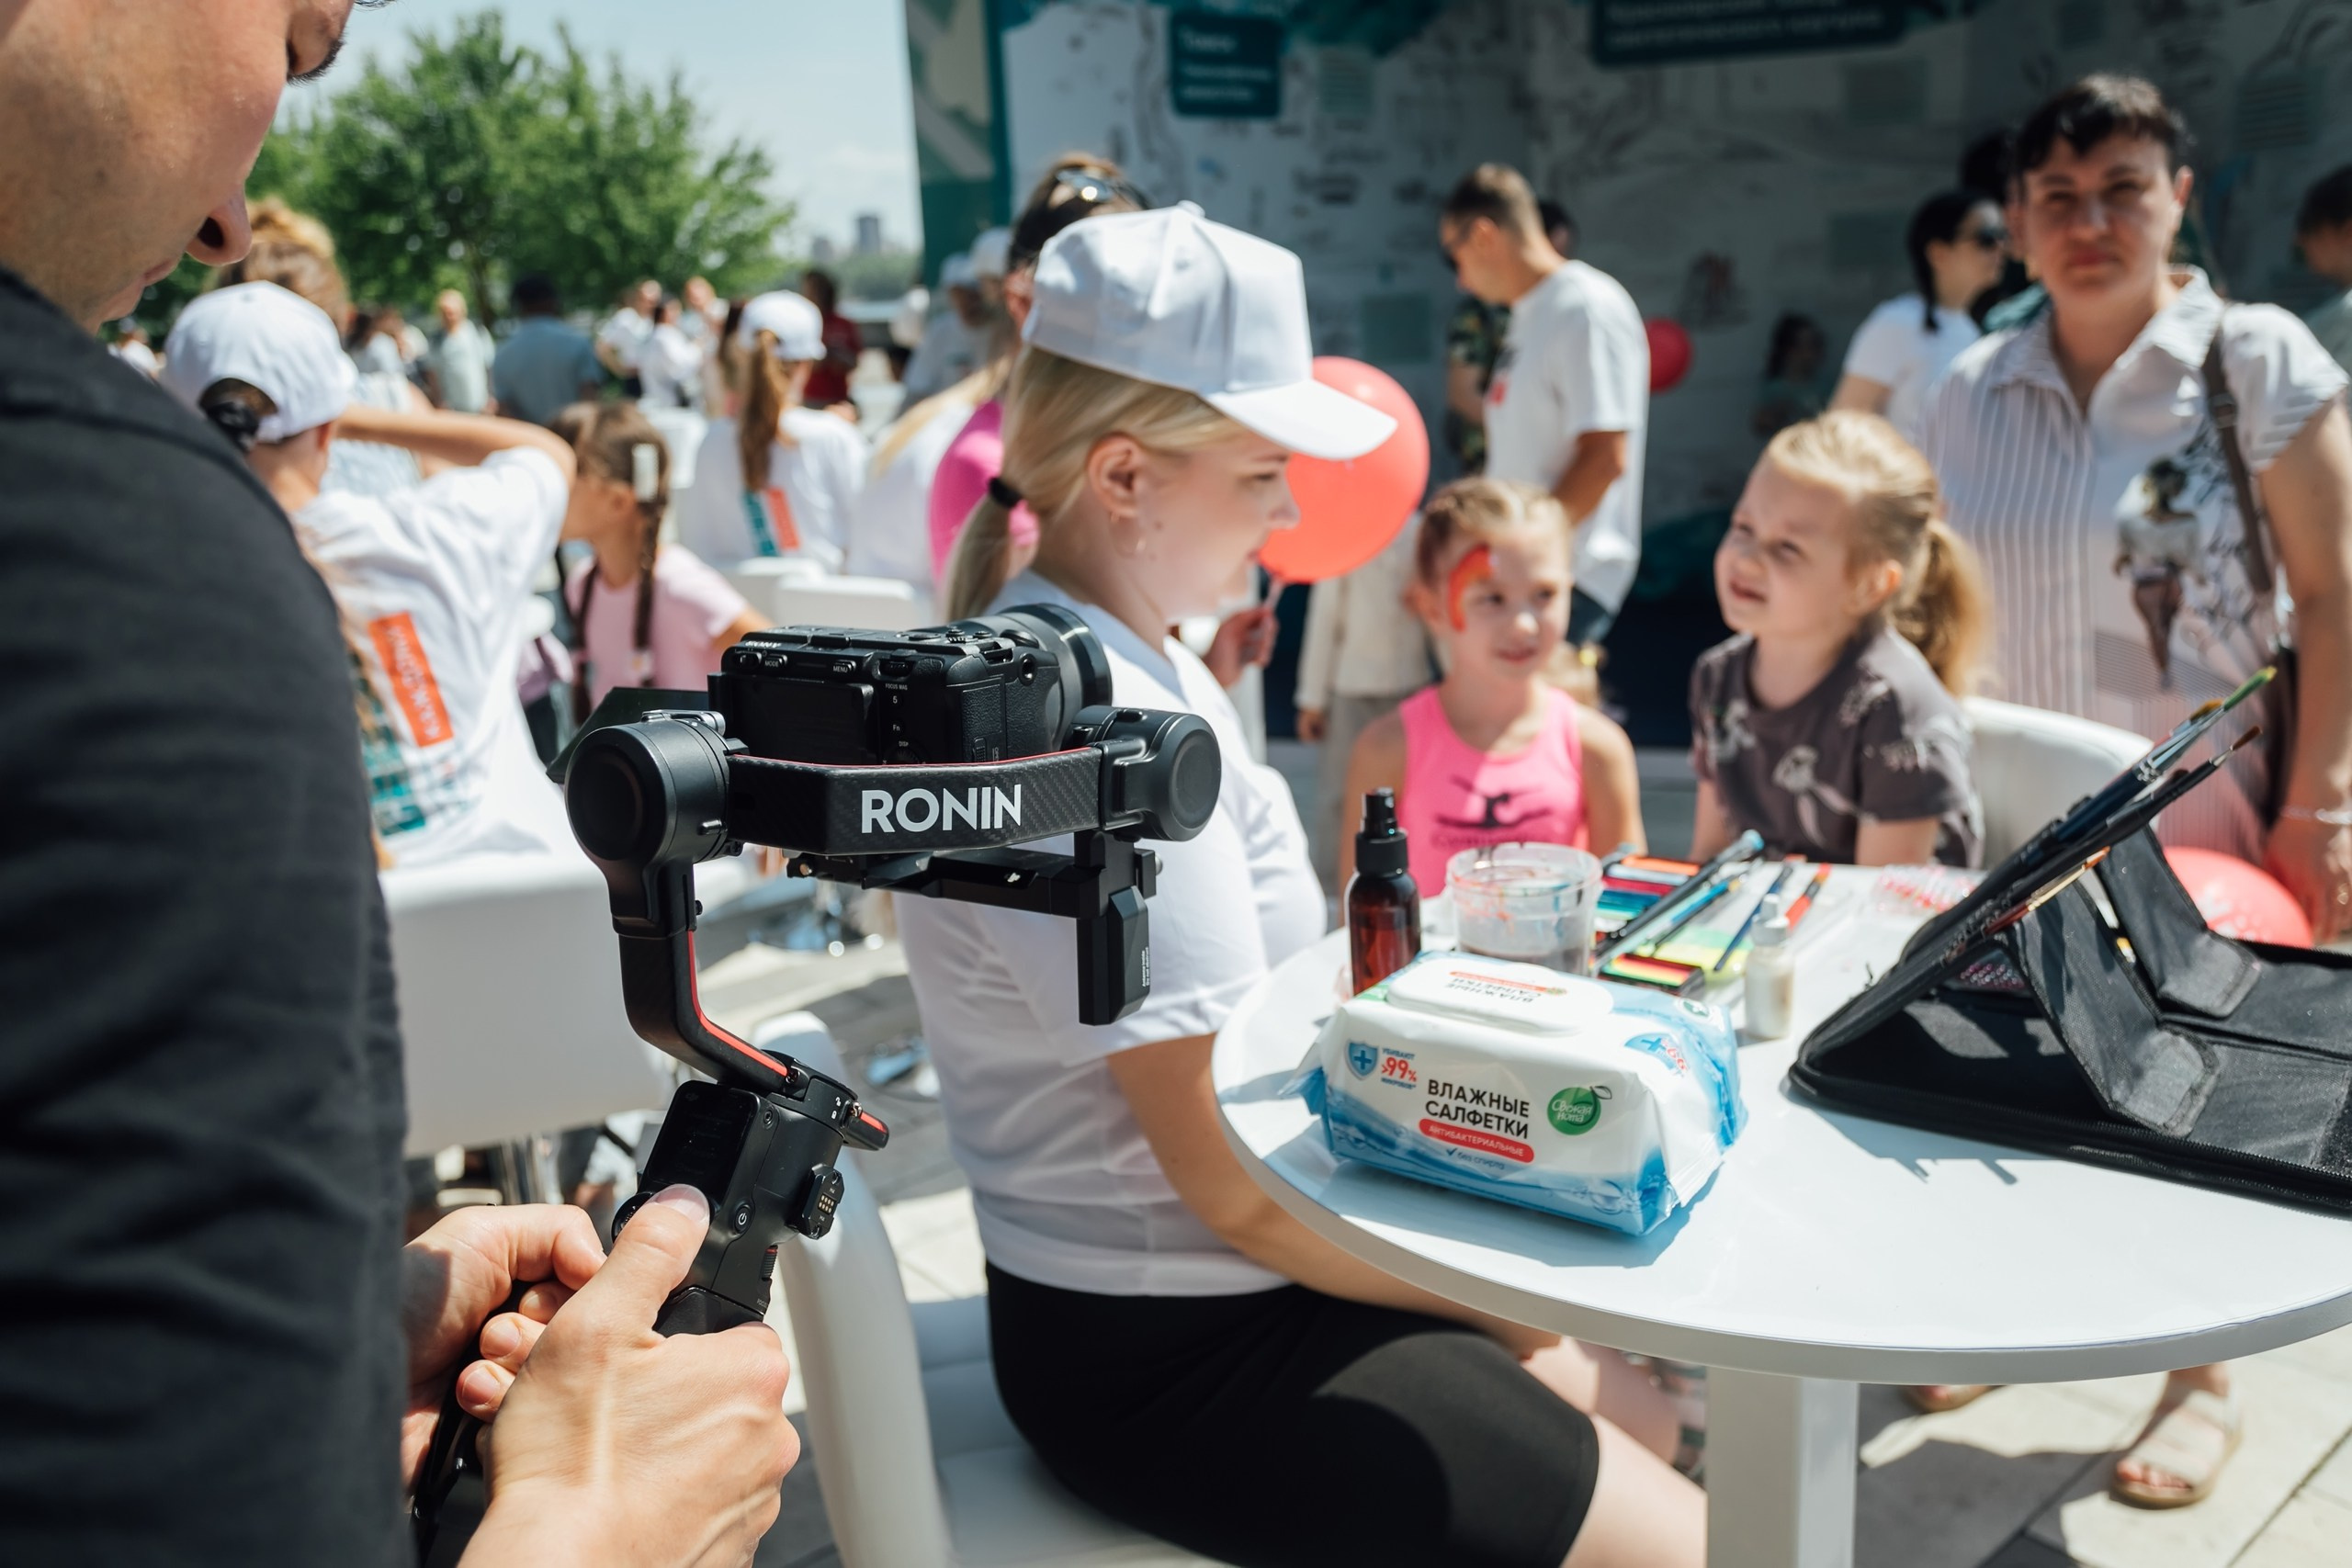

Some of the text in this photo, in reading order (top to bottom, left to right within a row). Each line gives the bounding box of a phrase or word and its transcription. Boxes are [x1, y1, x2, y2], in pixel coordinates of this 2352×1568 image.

[832, 665, 848, 673] MENU
[892, 695, 898, 704] 5
[861, 784, 1022, 834] RONIN
[1428, 1078, 1530, 1118] ВЛАЖНЫЕ
[1425, 1100, 1529, 1140] САЛФЕТКИ
[1428, 1125, 1524, 1157] АНТИБАКТЕРИАЛЬНЫЕ
